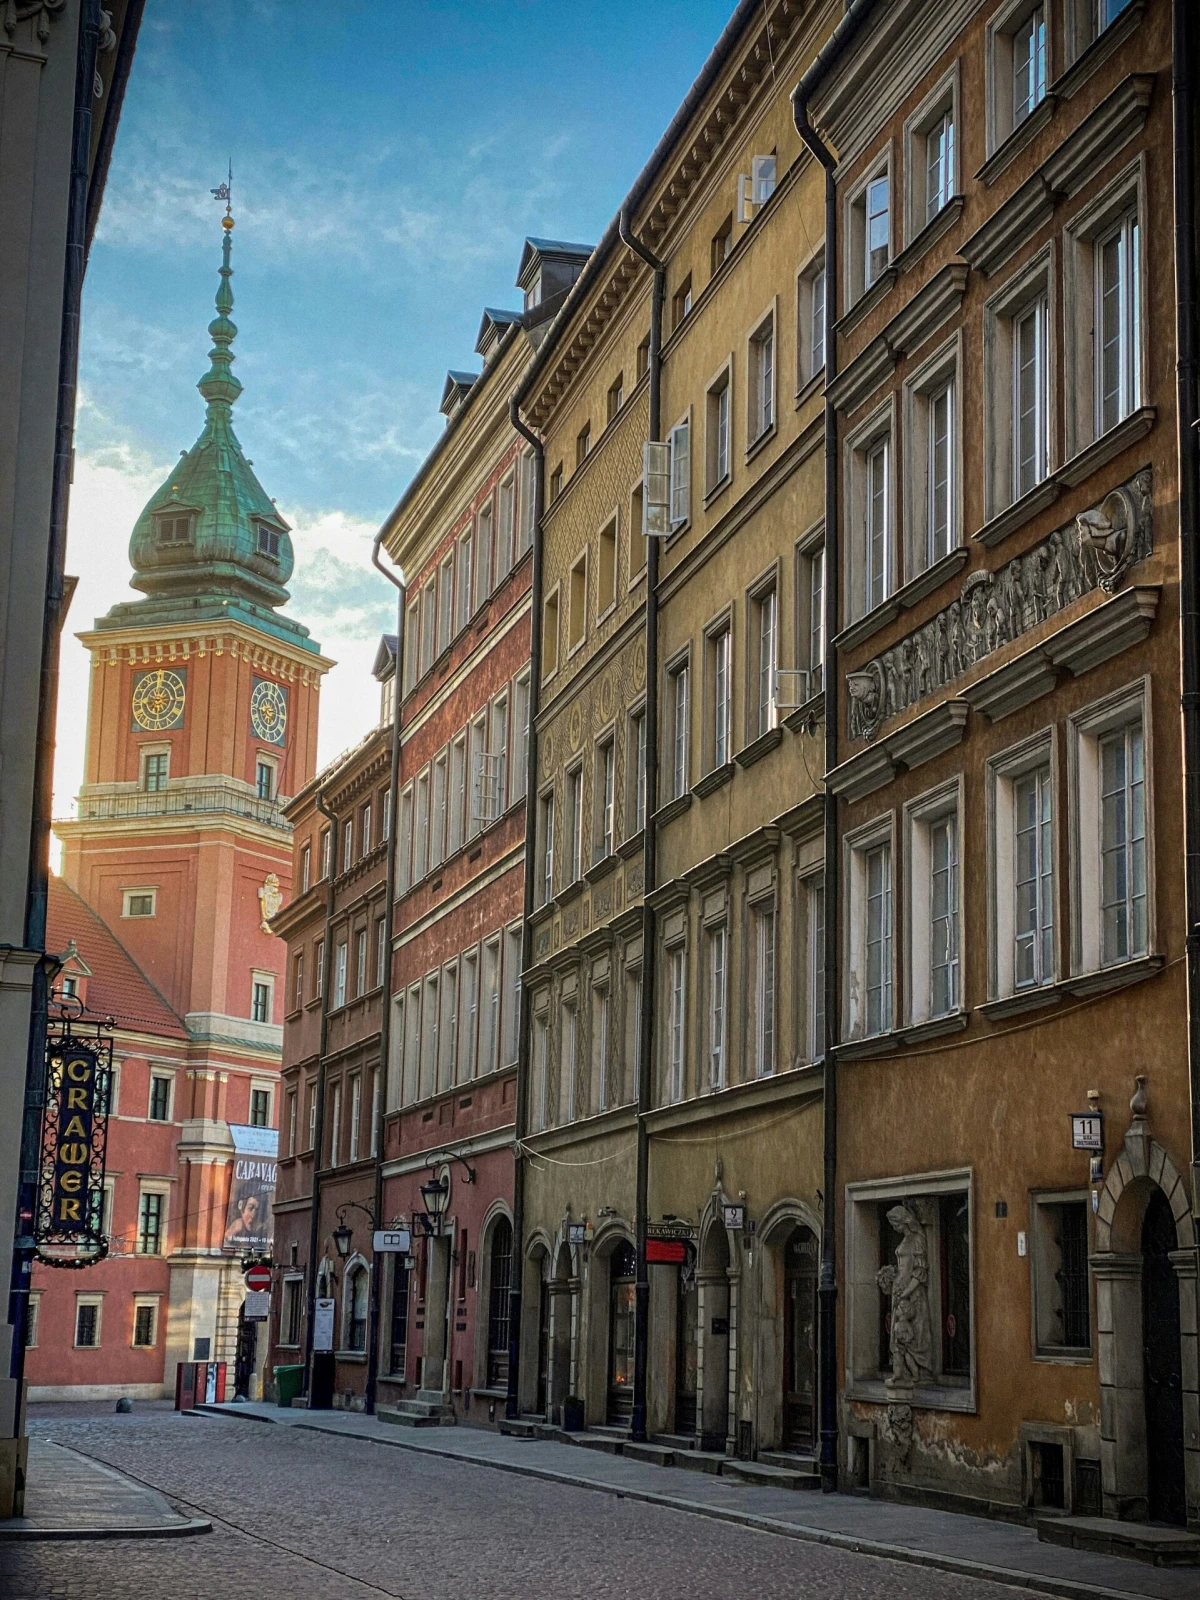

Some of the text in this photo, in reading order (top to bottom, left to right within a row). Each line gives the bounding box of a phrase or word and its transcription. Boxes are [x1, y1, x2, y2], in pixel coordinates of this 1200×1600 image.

[1080, 1119, 1093, 1135] 11
[59, 1059, 91, 1221] GRAWER
[731, 1208, 737, 1219] 9
